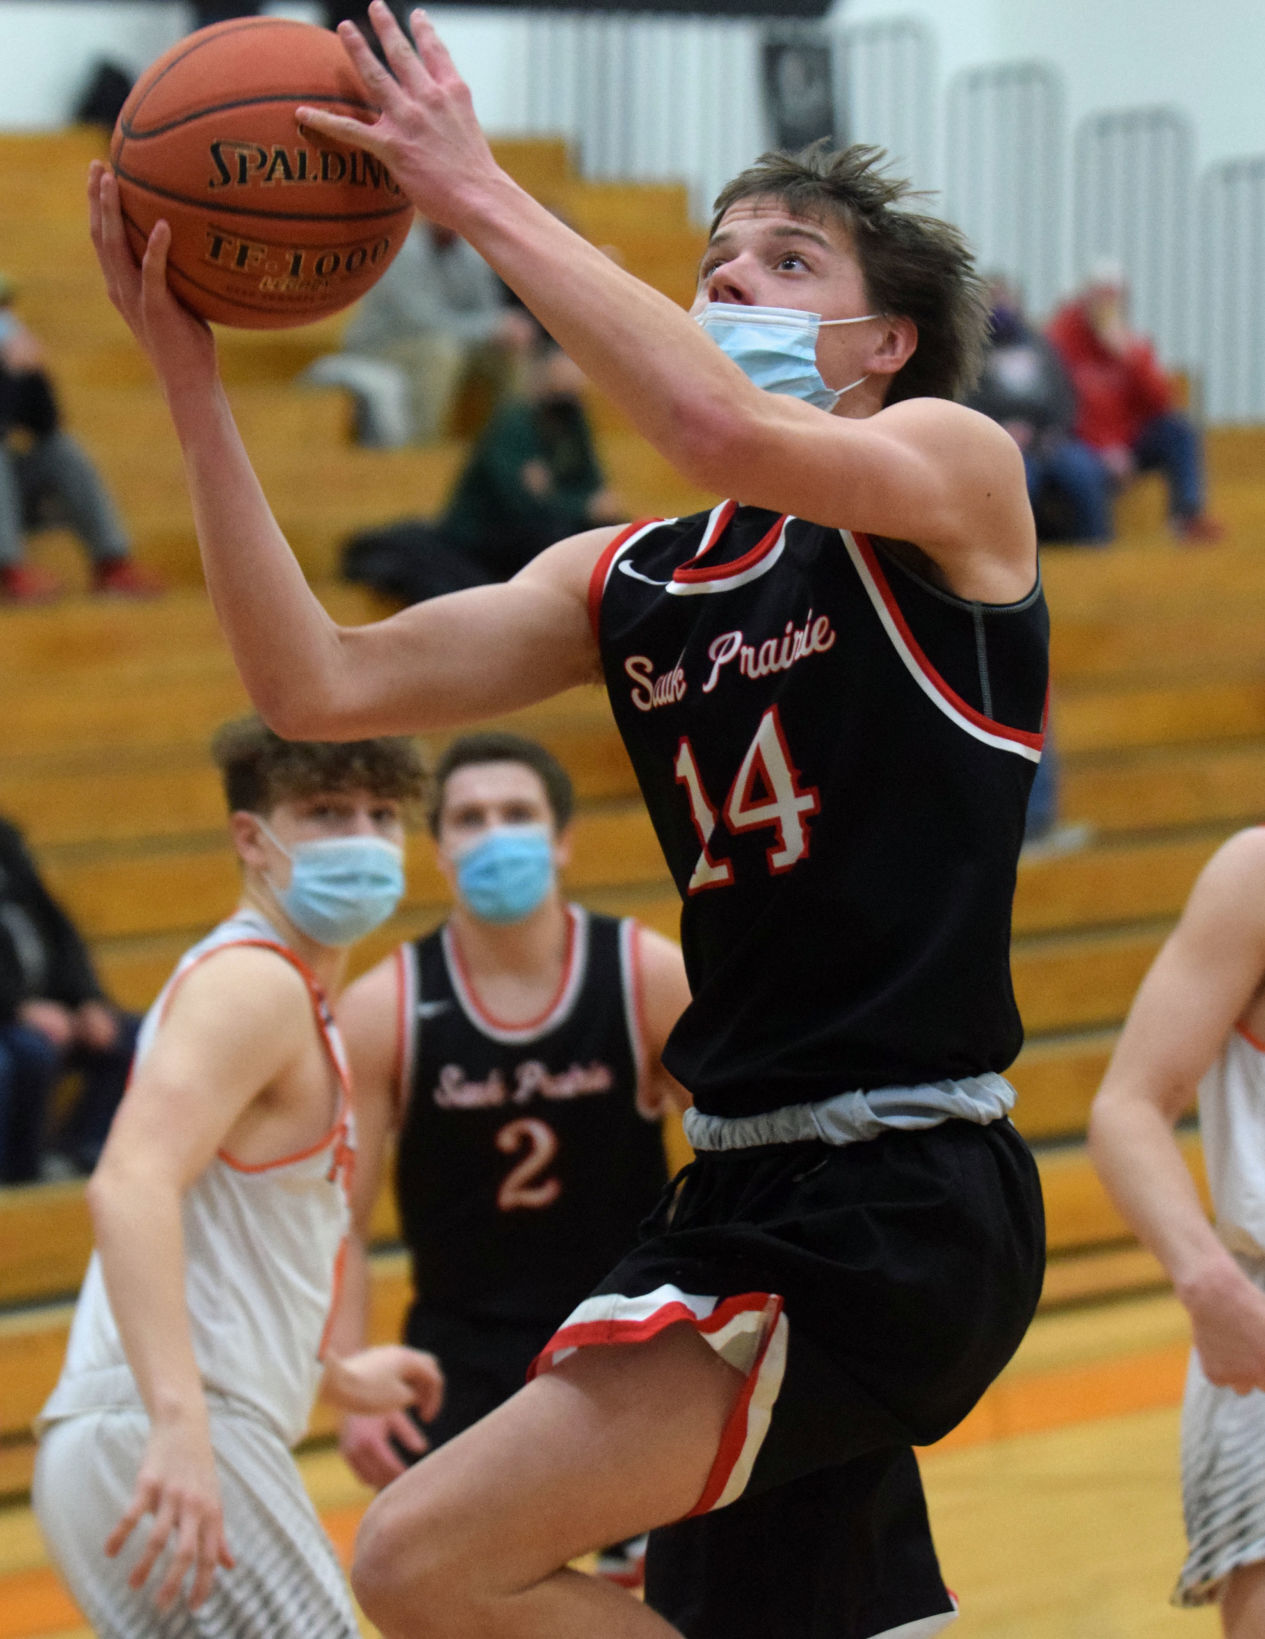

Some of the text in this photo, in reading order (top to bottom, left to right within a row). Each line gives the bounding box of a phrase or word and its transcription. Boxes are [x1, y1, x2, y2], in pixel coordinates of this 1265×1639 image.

[624, 608, 836, 711] Sauk Prairie
[674, 703, 821, 895] 14
[496, 1117, 561, 1212] 2
